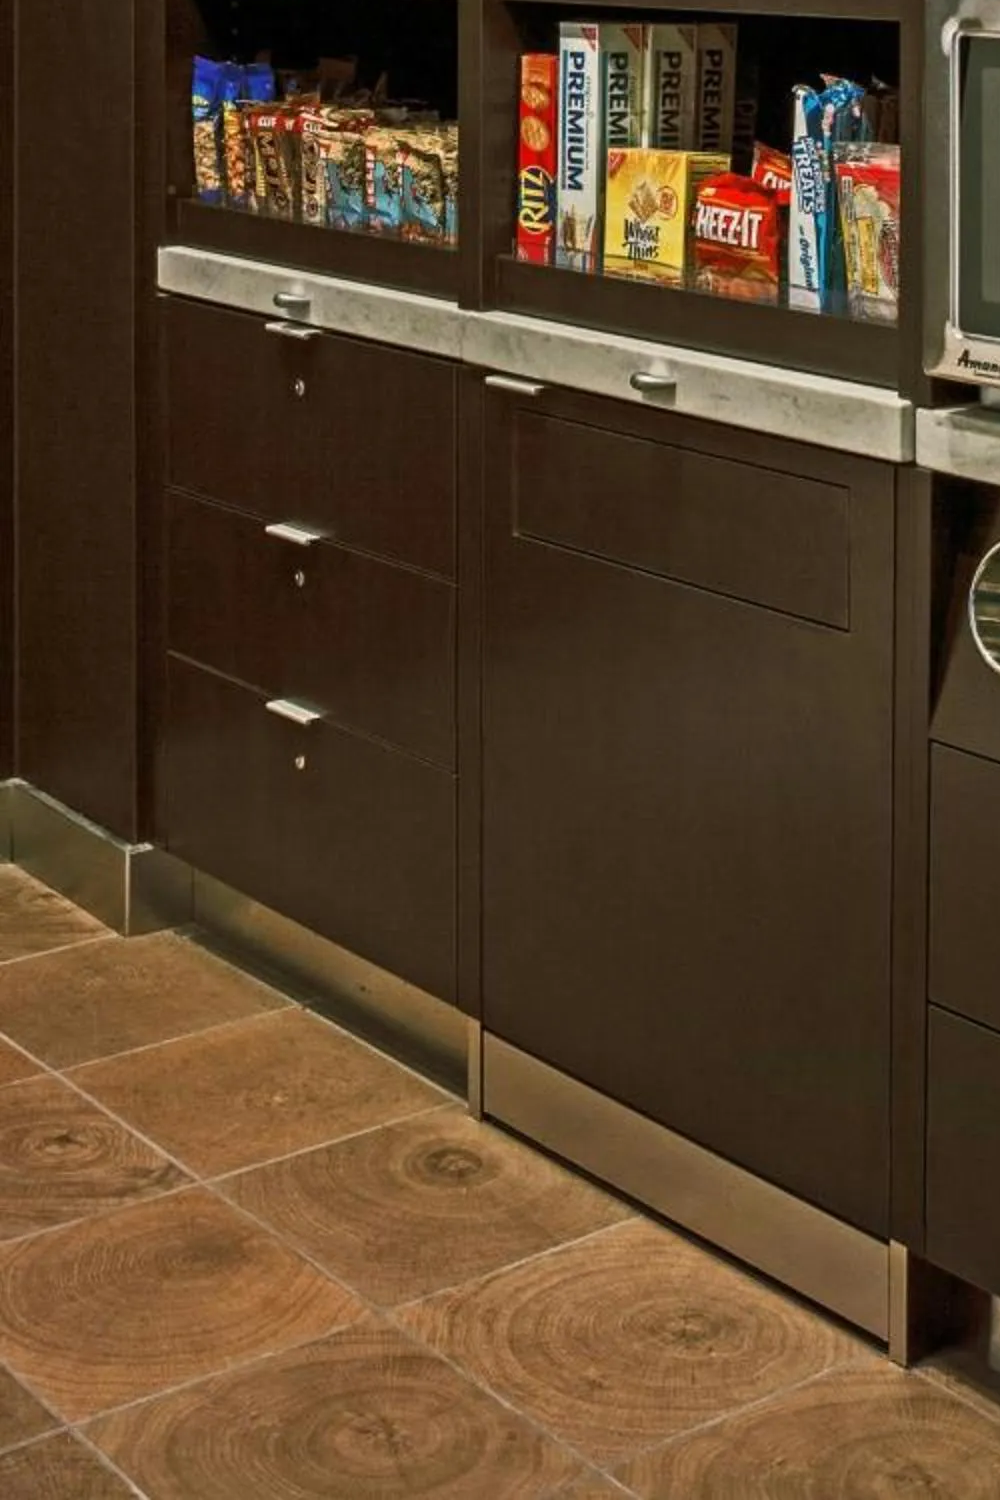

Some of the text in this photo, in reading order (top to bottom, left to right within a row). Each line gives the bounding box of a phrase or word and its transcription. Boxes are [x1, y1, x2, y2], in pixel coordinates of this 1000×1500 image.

[567, 51, 585, 191] PREMIUM
[519, 168, 551, 231] RITZ
[793, 139, 815, 214] TREATS
